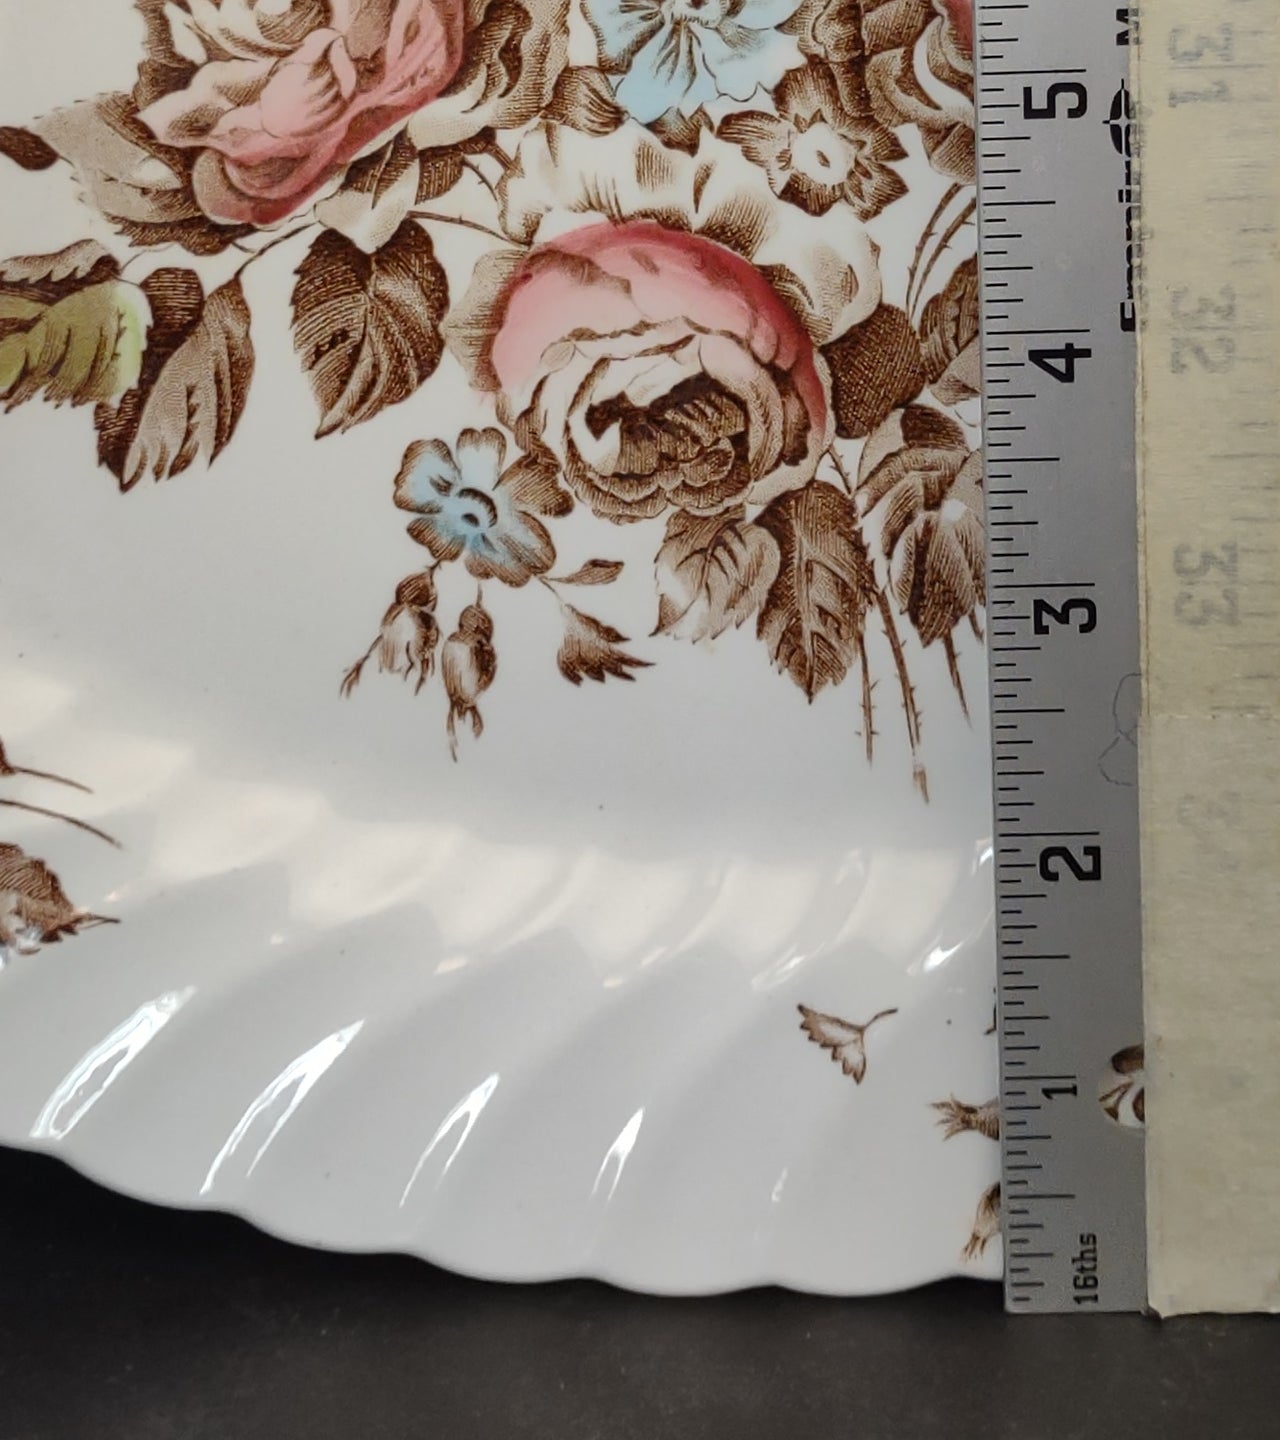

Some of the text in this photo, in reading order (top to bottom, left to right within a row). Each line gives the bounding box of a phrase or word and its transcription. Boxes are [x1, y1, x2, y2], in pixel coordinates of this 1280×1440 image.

[1023, 80, 1088, 120] 5
[1027, 341, 1092, 384] 4
[1033, 595, 1097, 635] 3
[1039, 843, 1102, 883] 2
[1041, 1081, 1078, 1100] 1
[1073, 1231, 1097, 1305] 16ths
